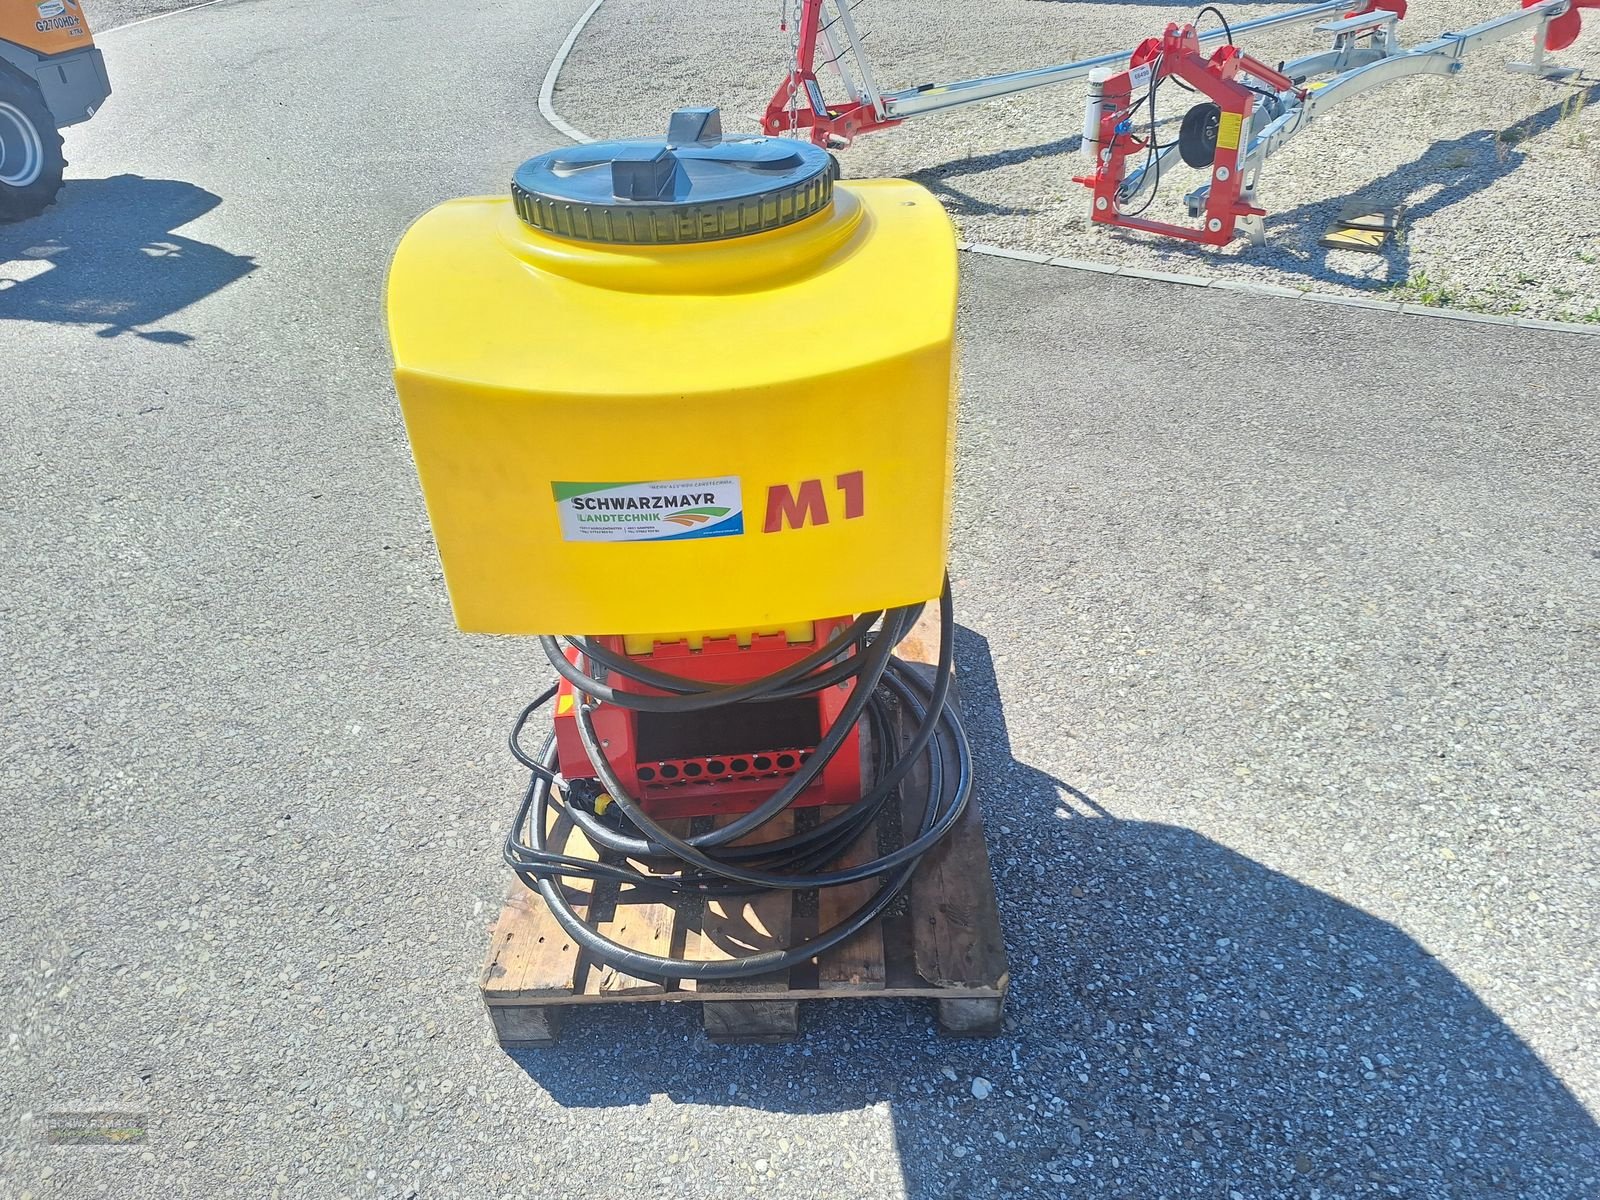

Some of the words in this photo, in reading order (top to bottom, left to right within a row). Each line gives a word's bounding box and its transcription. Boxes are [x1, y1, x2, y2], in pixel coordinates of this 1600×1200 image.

[36, 16, 80, 31] G2700HD+
[572, 493, 715, 510] SCHWARZMAYR
[763, 470, 865, 533] M1
[578, 512, 661, 522] LANDTECHNIK
